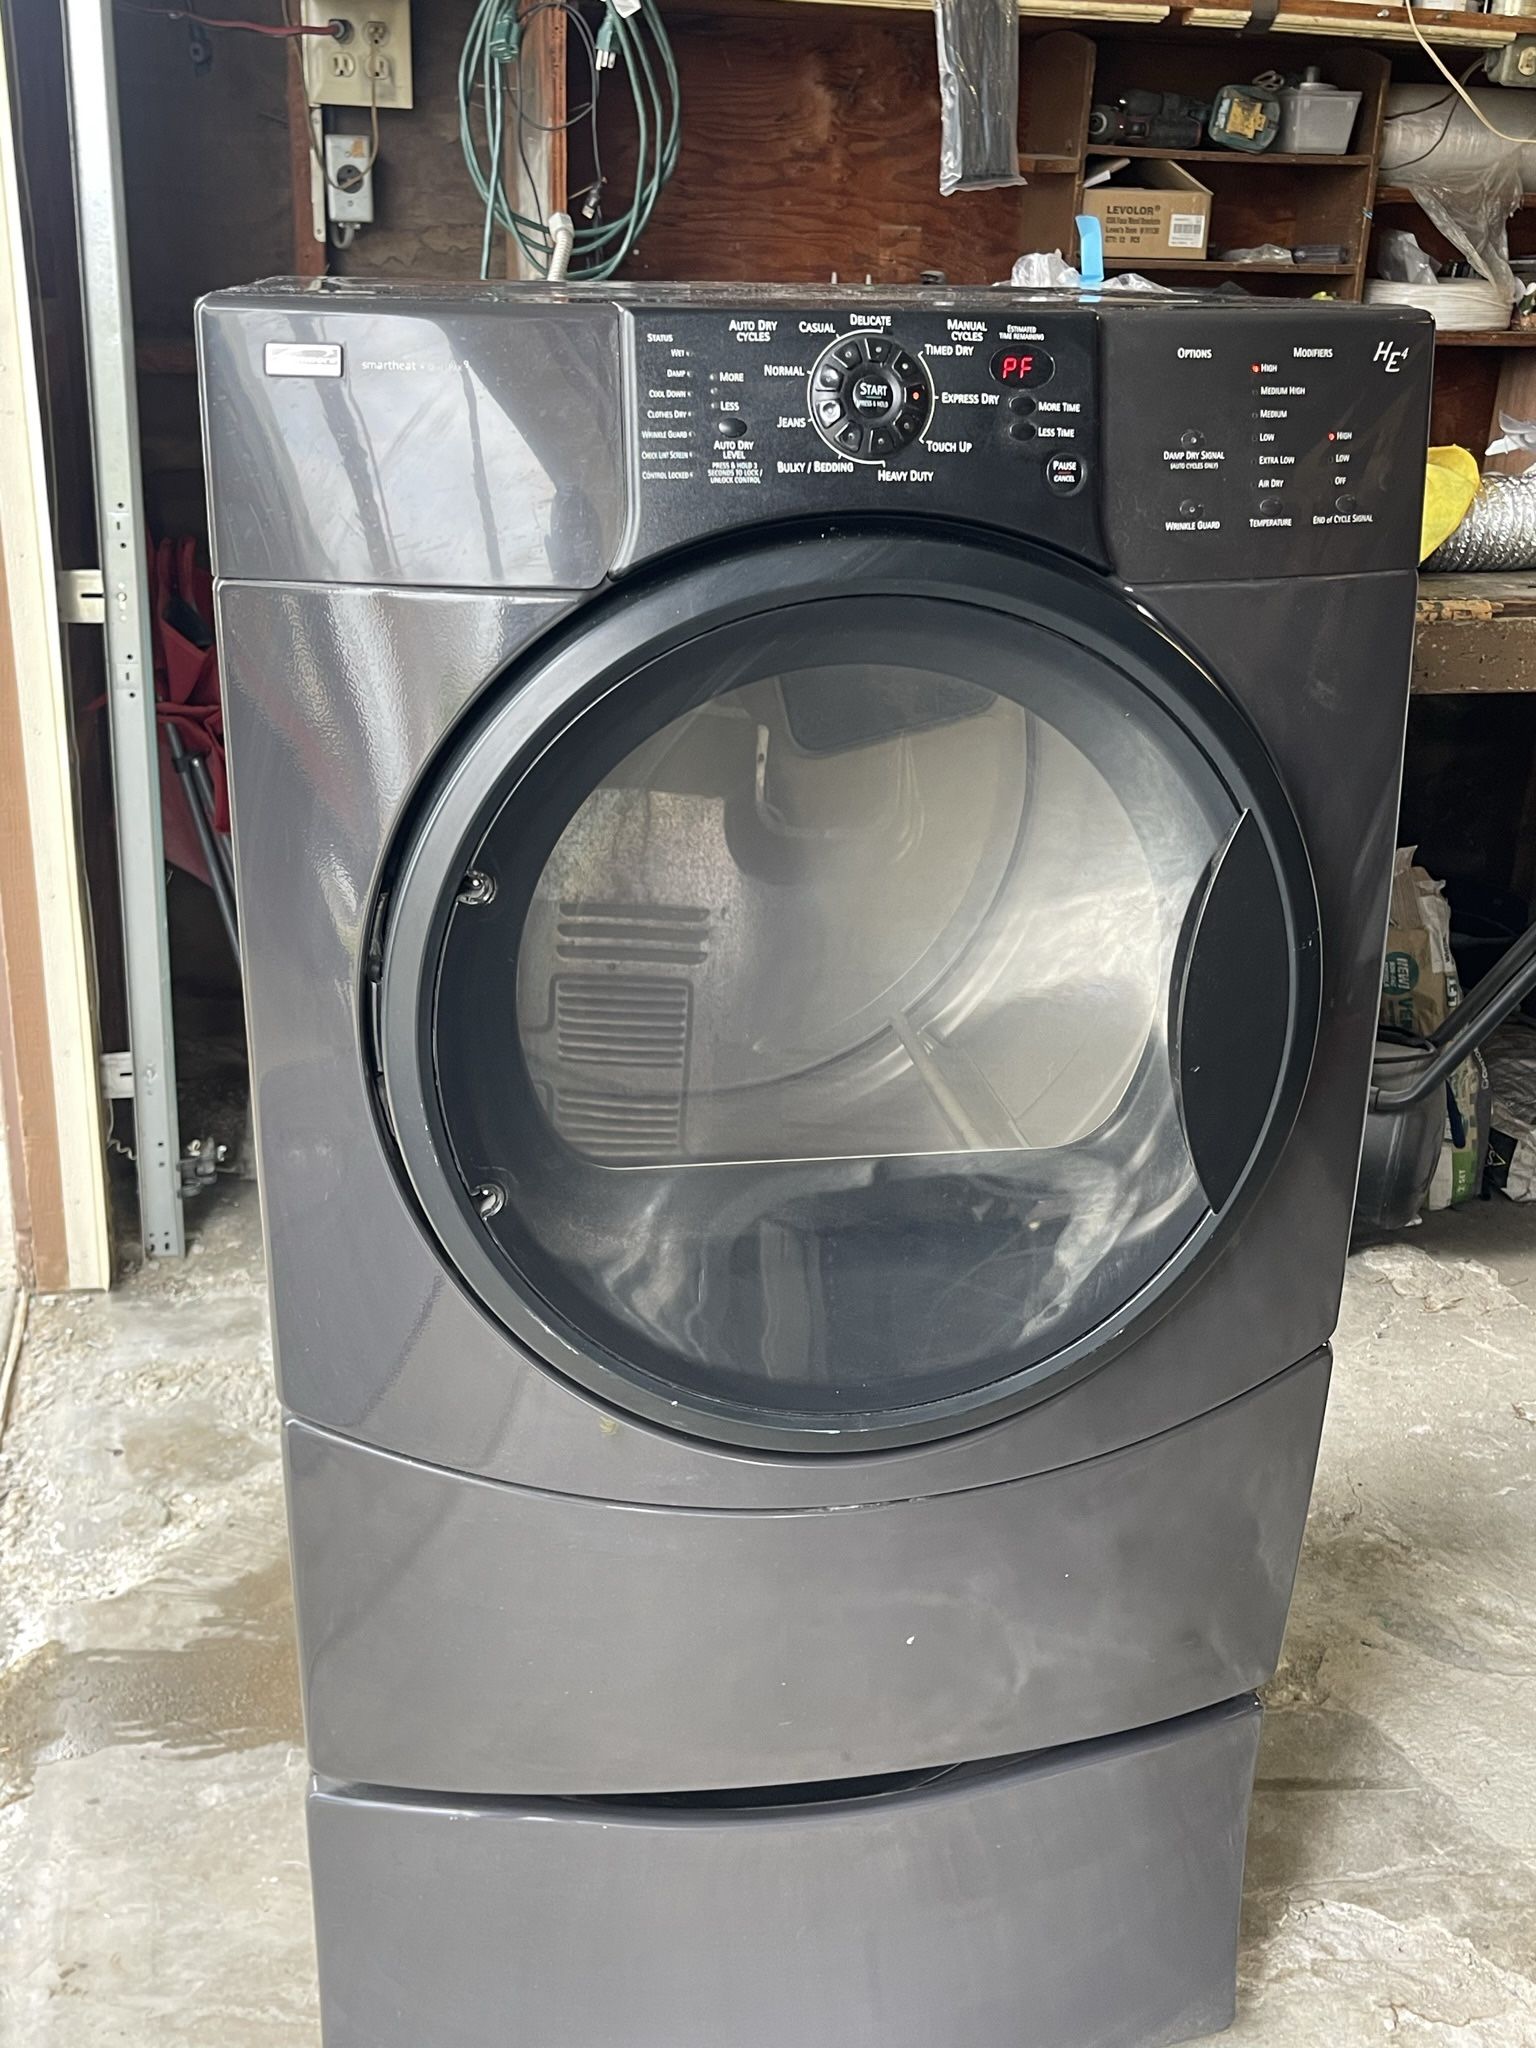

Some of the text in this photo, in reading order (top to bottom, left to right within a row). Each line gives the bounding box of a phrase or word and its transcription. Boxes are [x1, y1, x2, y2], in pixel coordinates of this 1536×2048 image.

[850, 314, 892, 326] DELICATE
[728, 319, 778, 332] AUTO DRY
[798, 321, 836, 333] CASUAL
[947, 319, 988, 332] MANUAL
[1007, 324, 1037, 333] ESTIMATED
[646, 333, 674, 342] STATUS
[736, 332, 771, 342] CYCLES
[951, 332, 984, 342] CYCLES
[999, 332, 1045, 341] TIME REMAINING
[670, 349, 685, 357] WET
[924, 343, 975, 356] TIMED DRY
[1177, 347, 1212, 359] OPTIONS
[1293, 347, 1333, 358] MODIFIERS
[361, 359, 417, 371] smartheat
[1002, 356, 1034, 379] PF
[1261, 363, 1278, 373] HIGH
[667, 369, 686, 378] DAMP
[764, 364, 805, 377] NORMAL
[719, 372, 745, 382] MORE
[648, 390, 687, 398] COOL DOWN
[860, 382, 888, 397] START
[1260, 386, 1306, 396] MEDIUM HIGH
[941, 392, 1000, 405] EXPRESS DRY
[720, 401, 740, 411] LESS
[1038, 402, 1081, 413] MORE TIME
[647, 410, 687, 419] CLOTHES DRY
[1260, 409, 1288, 419] MEDIUM
[776, 416, 807, 429] JEANS
[641, 430, 688, 439] WRINKLE GUARD
[1037, 426, 1075, 438] LESS TIME
[1259, 432, 1275, 442] LOW
[1336, 431, 1353, 440] HIGH
[713, 440, 755, 450] AUTO DRY
[926, 440, 973, 453] TOUCH UP
[722, 450, 746, 460] LEVEL
[1163, 450, 1225, 460] DAMP DRY SIGNAL
[1258, 455, 1295, 465] EXTRA LOW
[1335, 453, 1350, 463] LOW
[712, 461, 730, 469] PRESS
[737, 461, 752, 469] HOLD
[777, 460, 854, 474] BULKY / BEDDING
[1053, 460, 1077, 471] PAUSE
[1186, 462, 1203, 470] CYCLES
[642, 471, 690, 480] CONTROL LOCKED
[707, 469, 734, 477] SECONDS
[744, 469, 759, 477] LOCK
[878, 470, 934, 482] HEAVY DUTY
[1053, 474, 1076, 483] CANCEL
[1258, 479, 1284, 488] AIR DRY
[1334, 476, 1347, 485] OFF
[1249, 517, 1292, 528] TEMPERATURE
[1312, 515, 1325, 525] END
[1333, 514, 1351, 524] CYCLE
[1352, 514, 1374, 523] SIGNAL
[1165, 520, 1220, 532] WRINKLE GUARD
